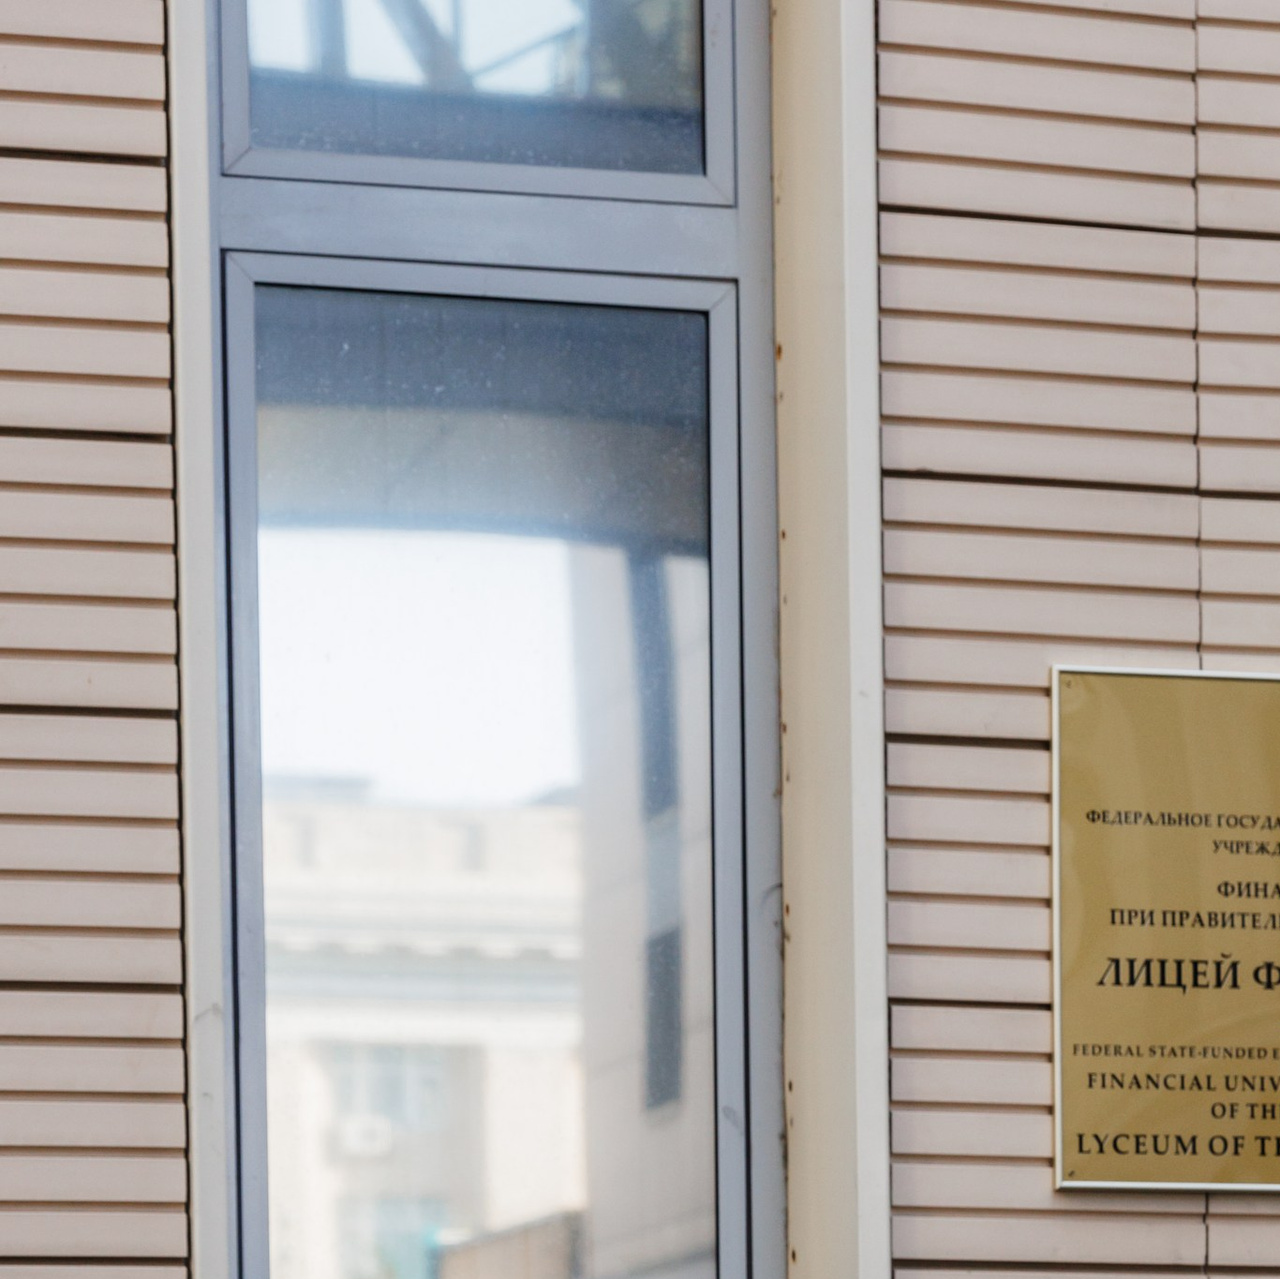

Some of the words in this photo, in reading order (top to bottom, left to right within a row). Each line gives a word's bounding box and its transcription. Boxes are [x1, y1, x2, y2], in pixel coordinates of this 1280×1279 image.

[1086, 809, 1212, 828] ФЕДЕРАЛЬНОЕ
[1110, 908, 1155, 927] ПРИ
[1096, 953, 1241, 995] ЛИЦЕЙ
[1072, 1044, 1144, 1057] FEDERAL
[1149, 1045, 1268, 1060] STATE-FUNDED
[1087, 1072, 1217, 1091] FINANCIAL
[1210, 1102, 1240, 1119] OF
[1076, 1133, 1199, 1155] LYCEUM
[1207, 1135, 1246, 1156] OF
